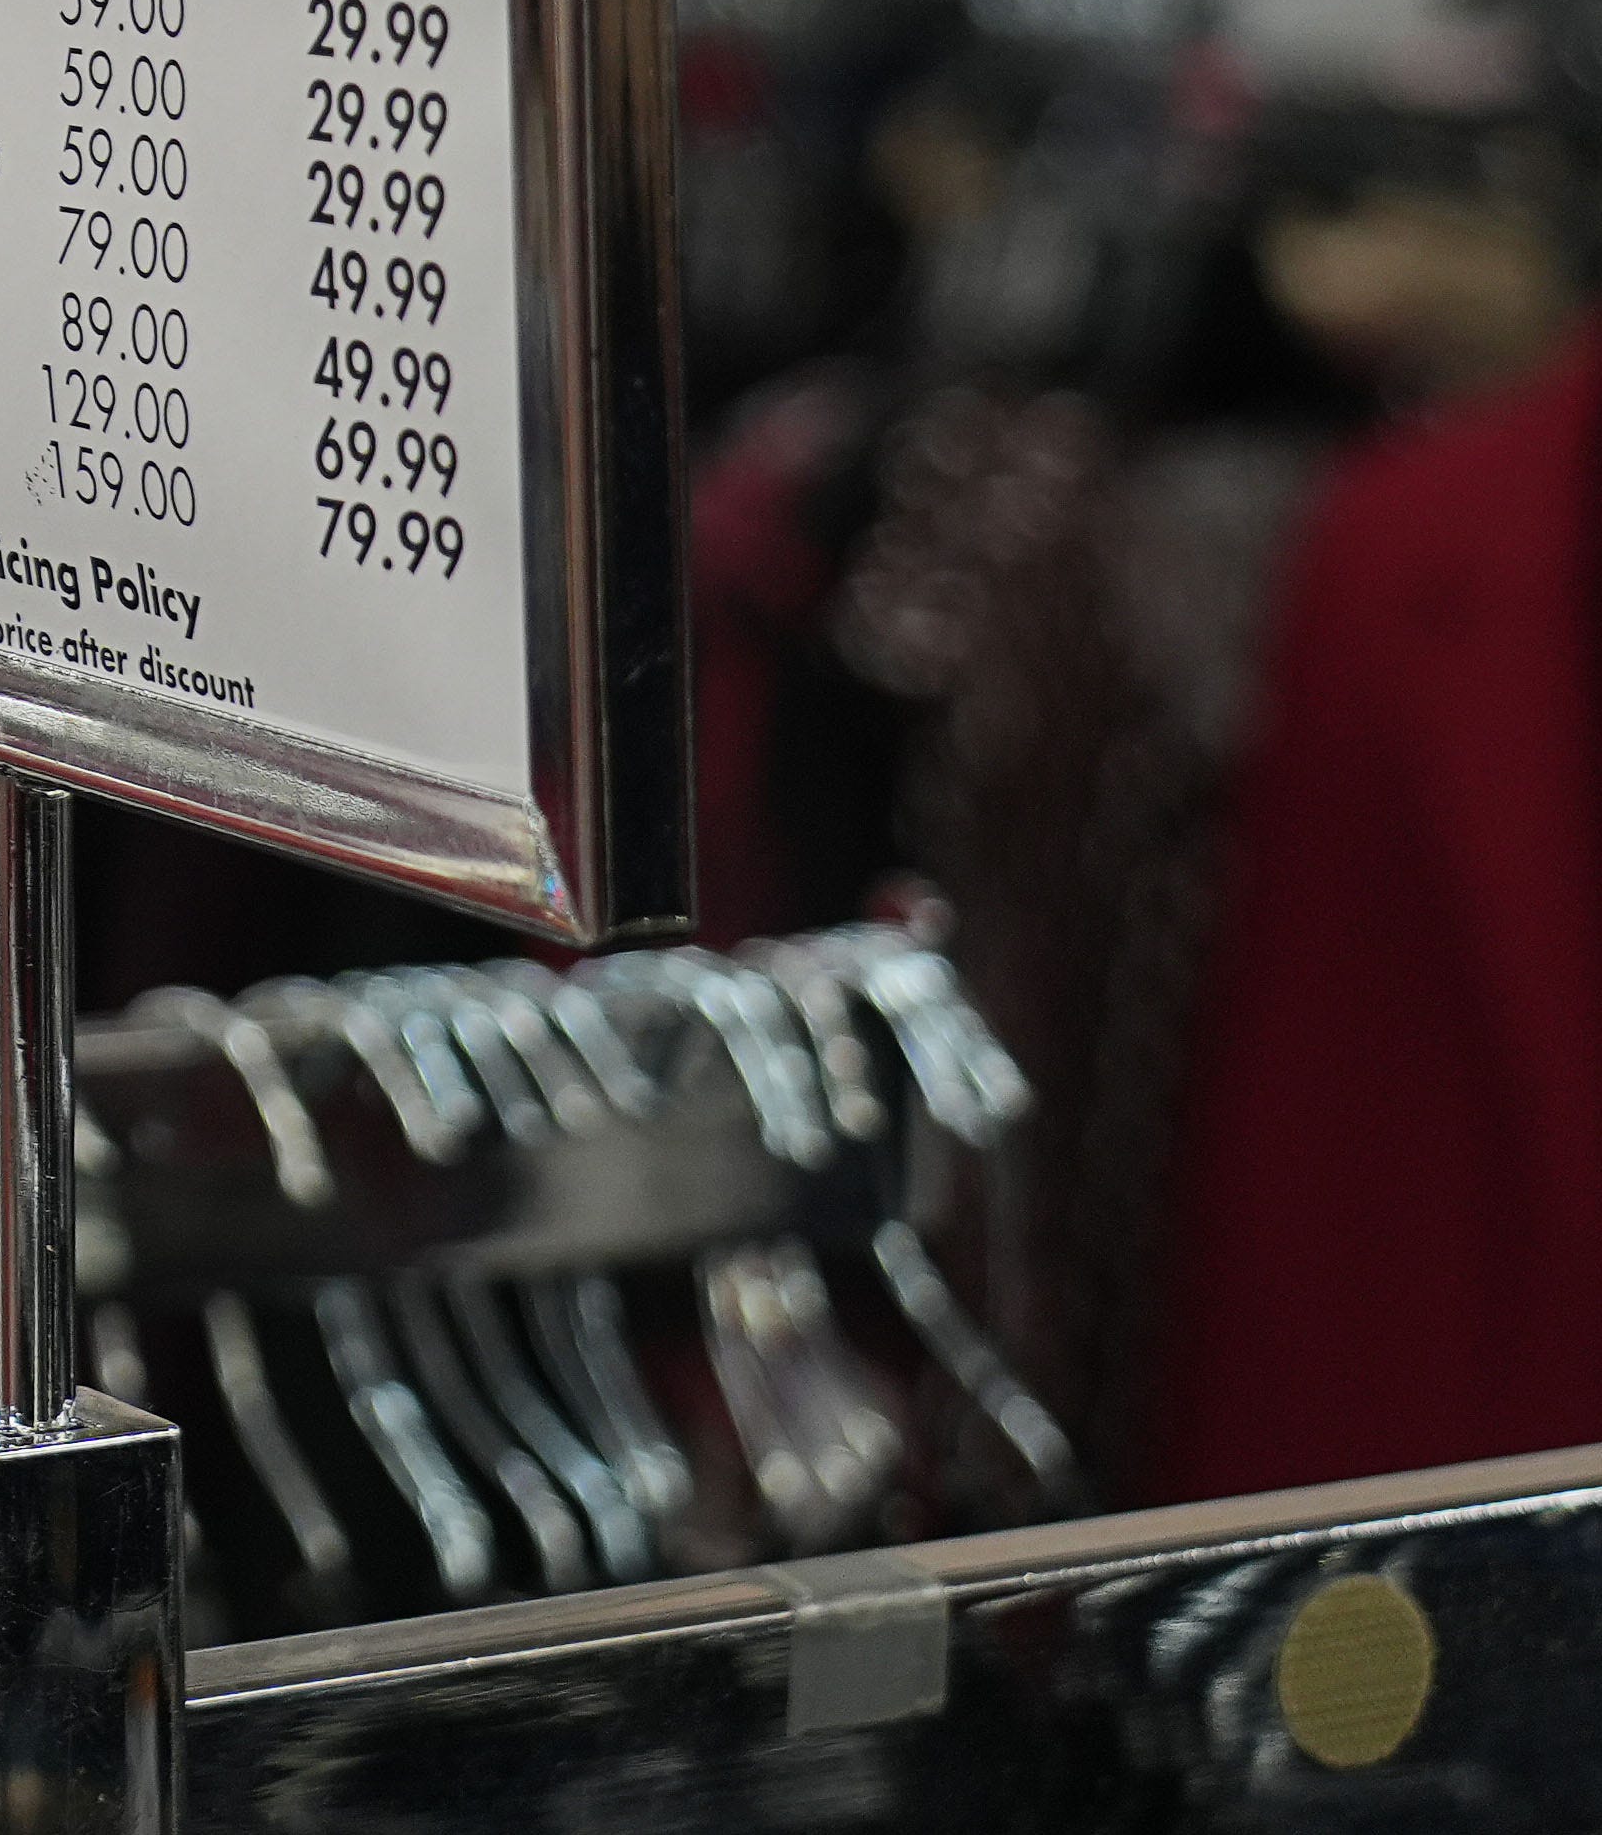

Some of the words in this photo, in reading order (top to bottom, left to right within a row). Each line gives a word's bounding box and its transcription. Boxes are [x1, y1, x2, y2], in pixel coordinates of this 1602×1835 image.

[60, 47, 185, 120] 59.00
[307, 79, 447, 156] 29.99
[59, 125, 187, 200] 59.00
[307, 160, 445, 239] 29.99
[59, 206, 188, 283] 79.00
[310, 247, 446, 326] 49.99
[62, 292, 187, 369] 89.00
[314, 336, 451, 415] 49.99
[42, 364, 189, 449] 129.00
[316, 417, 457, 498] 69.99
[49, 441, 195, 526] 159.00
[317, 497, 463, 580] 79.99
[89, 556, 201, 639] Policy
[62, 628, 128, 675] after
[139, 647, 254, 709] discount
